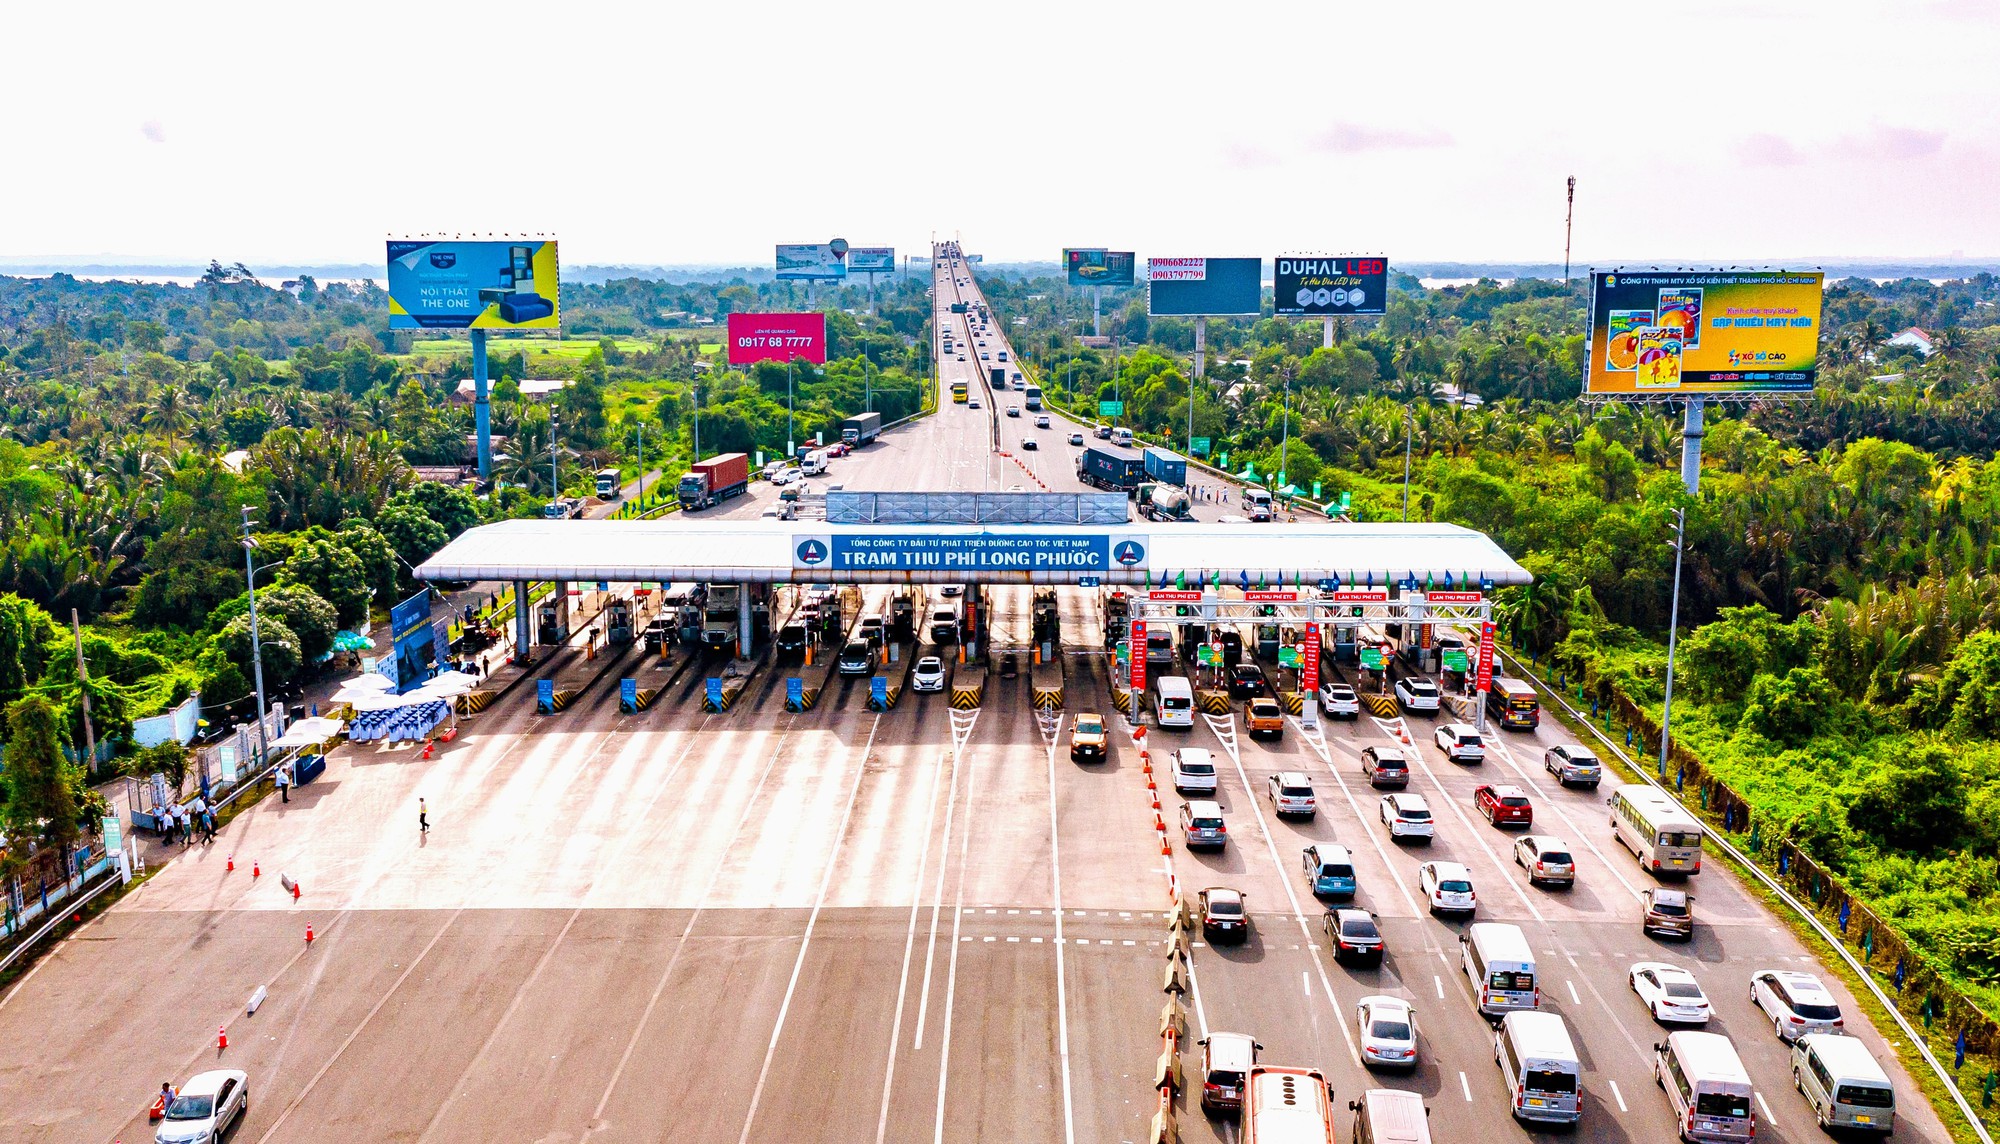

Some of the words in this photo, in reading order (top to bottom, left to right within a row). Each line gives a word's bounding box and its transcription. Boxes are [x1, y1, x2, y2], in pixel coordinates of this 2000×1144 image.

[1152, 258, 1204, 267] 0906682222
[1280, 260, 1342, 274] DUHAL
[1347, 260, 1383, 275] LED
[1152, 271, 1204, 279] 0903797799
[1696, 276, 1706, 284] SỐ
[1706, 276, 1720, 284] KIẾN
[1739, 276, 1760, 284] THÀNH
[1761, 276, 1775, 284] PHỐ
[420, 286, 439, 298] NỘI
[442, 284, 469, 296] THẤT
[422, 299, 443, 308] THE
[446, 299, 470, 308] ONE
[1766, 318, 1788, 328] MAY
[739, 337, 765, 347] 0917
[768, 337, 782, 347] 68
[786, 337, 812, 347] 7777
[1755, 350, 1766, 360] SỐ
[1768, 351, 1786, 360] CÀO
[850, 537, 870, 547] TỔNG
[873, 538, 895, 547] CÔNG
[910, 538, 926, 546] ĐẦU
[928, 538, 939, 546] TƯ
[941, 538, 961, 547] PHÁT
[964, 538, 986, 547] TRIỂN
[988, 538, 1015, 547] ĐƯỜNG
[1035, 538, 1050, 547] TỐC
[1052, 538, 1070, 547] VIỆT
[841, 552, 897, 568] TRẠM
[902, 552, 940, 565] THU
[945, 548, 977, 565] PHÍ
[981, 552, 1030, 565] LONG
[1035, 549, 1100, 565] PHƯỚC
